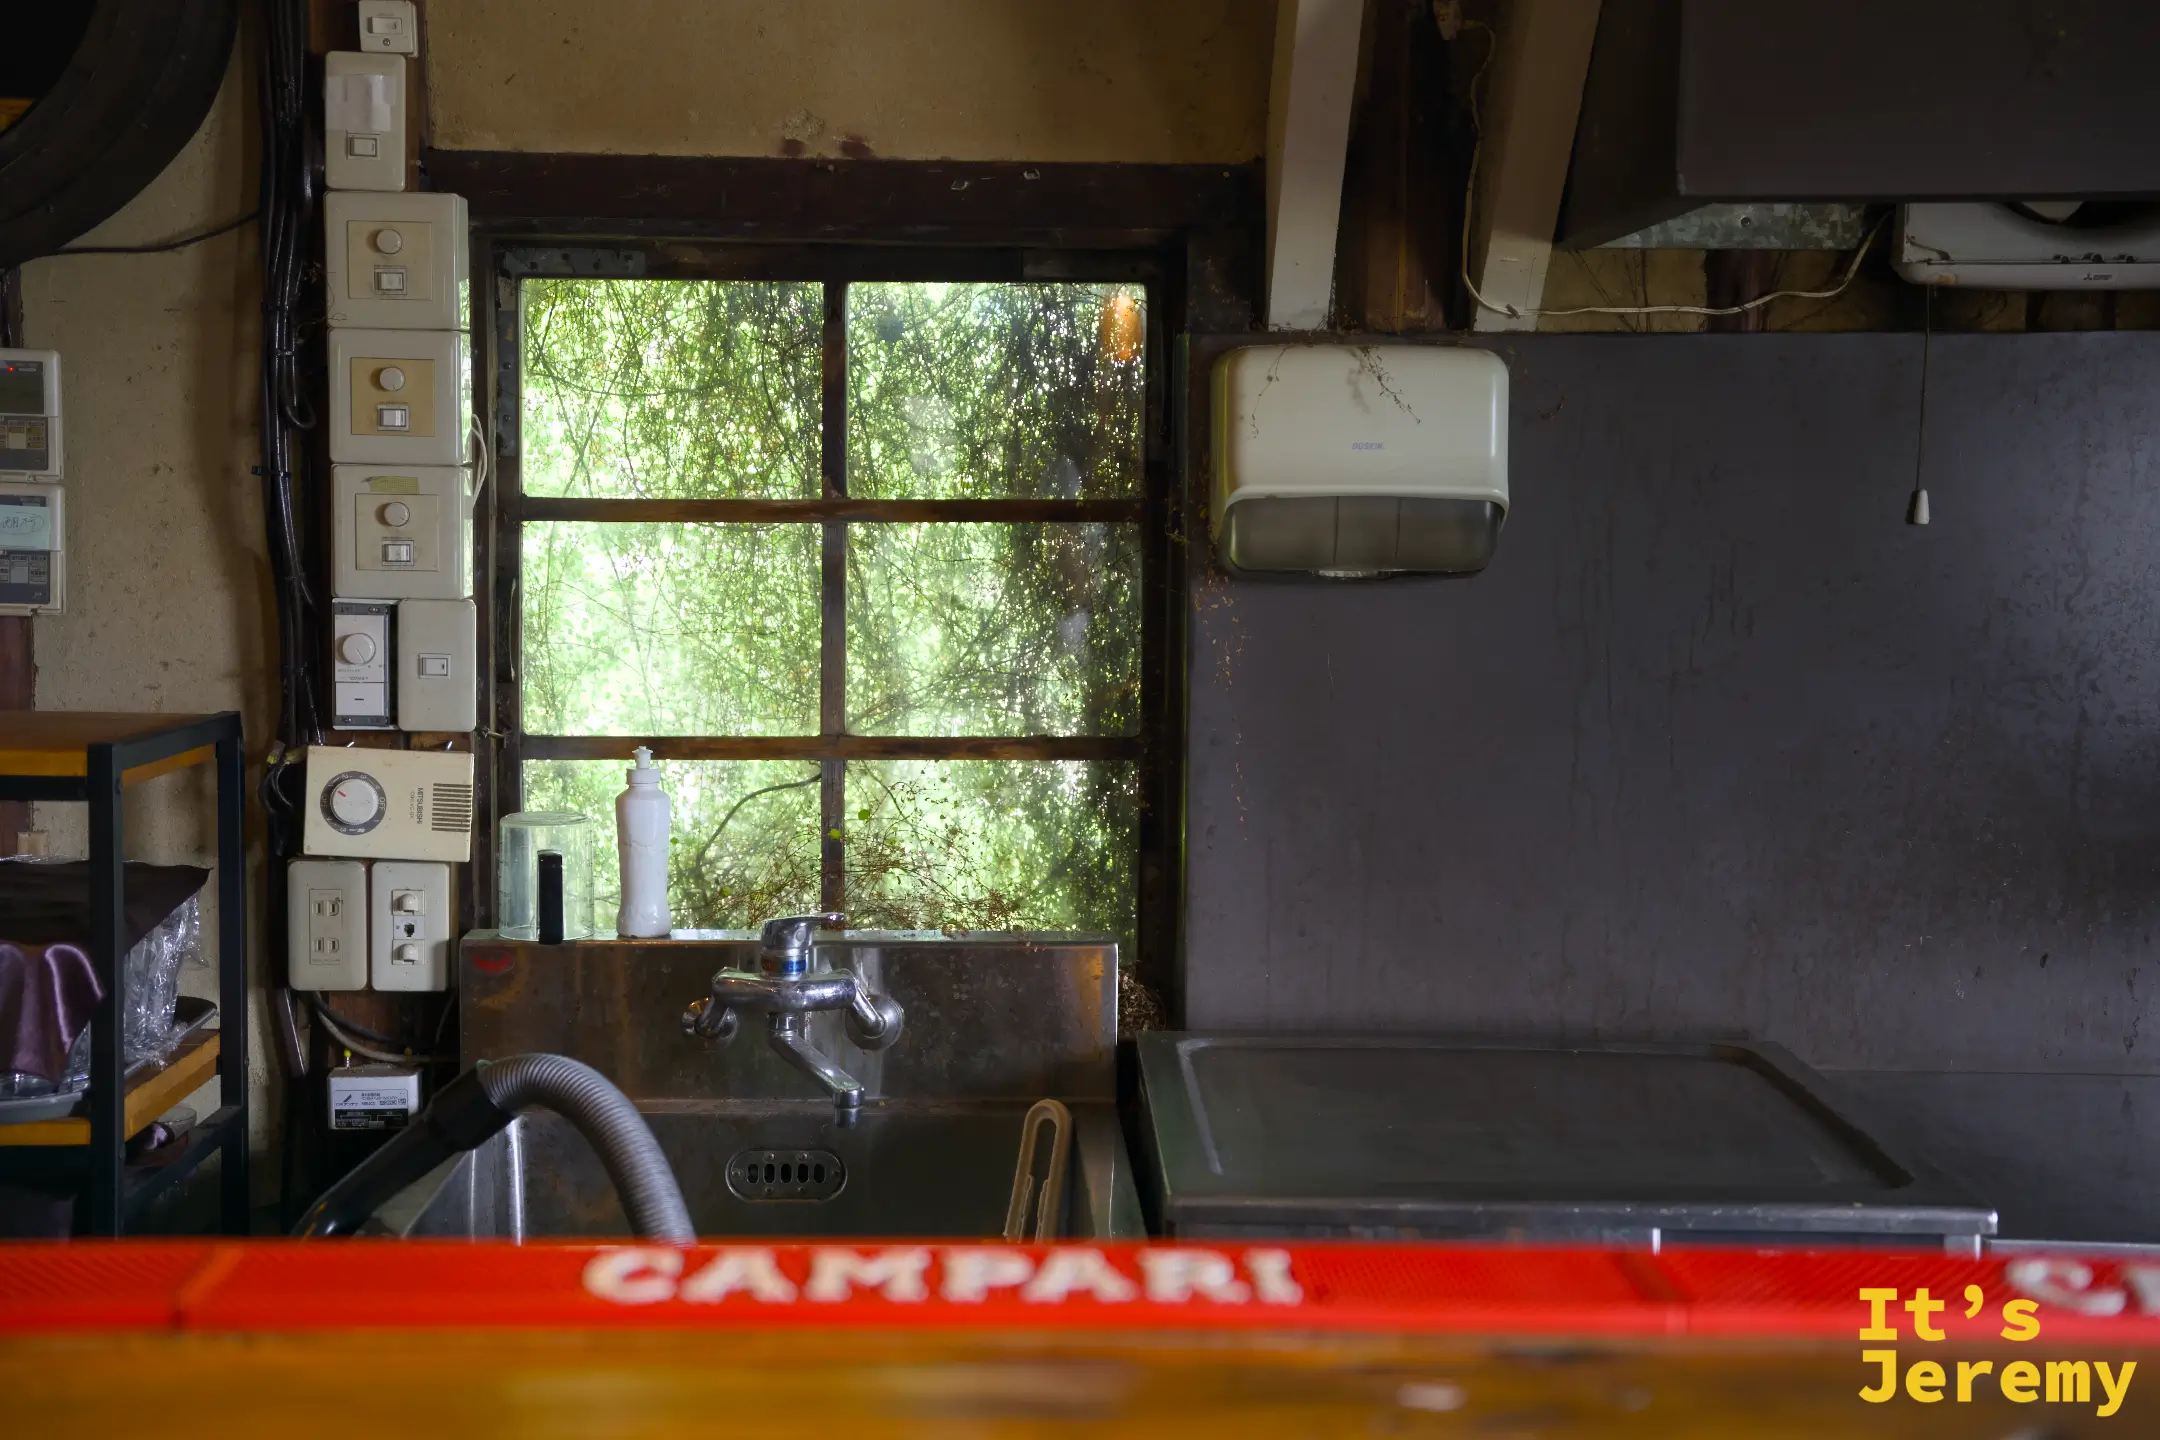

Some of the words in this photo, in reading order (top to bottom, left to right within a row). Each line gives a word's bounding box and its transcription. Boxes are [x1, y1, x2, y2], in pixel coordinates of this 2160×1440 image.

[379, 797, 387, 812] OFF
[416, 787, 425, 824] MITSUBISHI
[583, 1246, 1303, 1303] CAMPARI
[2005, 1259, 2160, 1316] C
